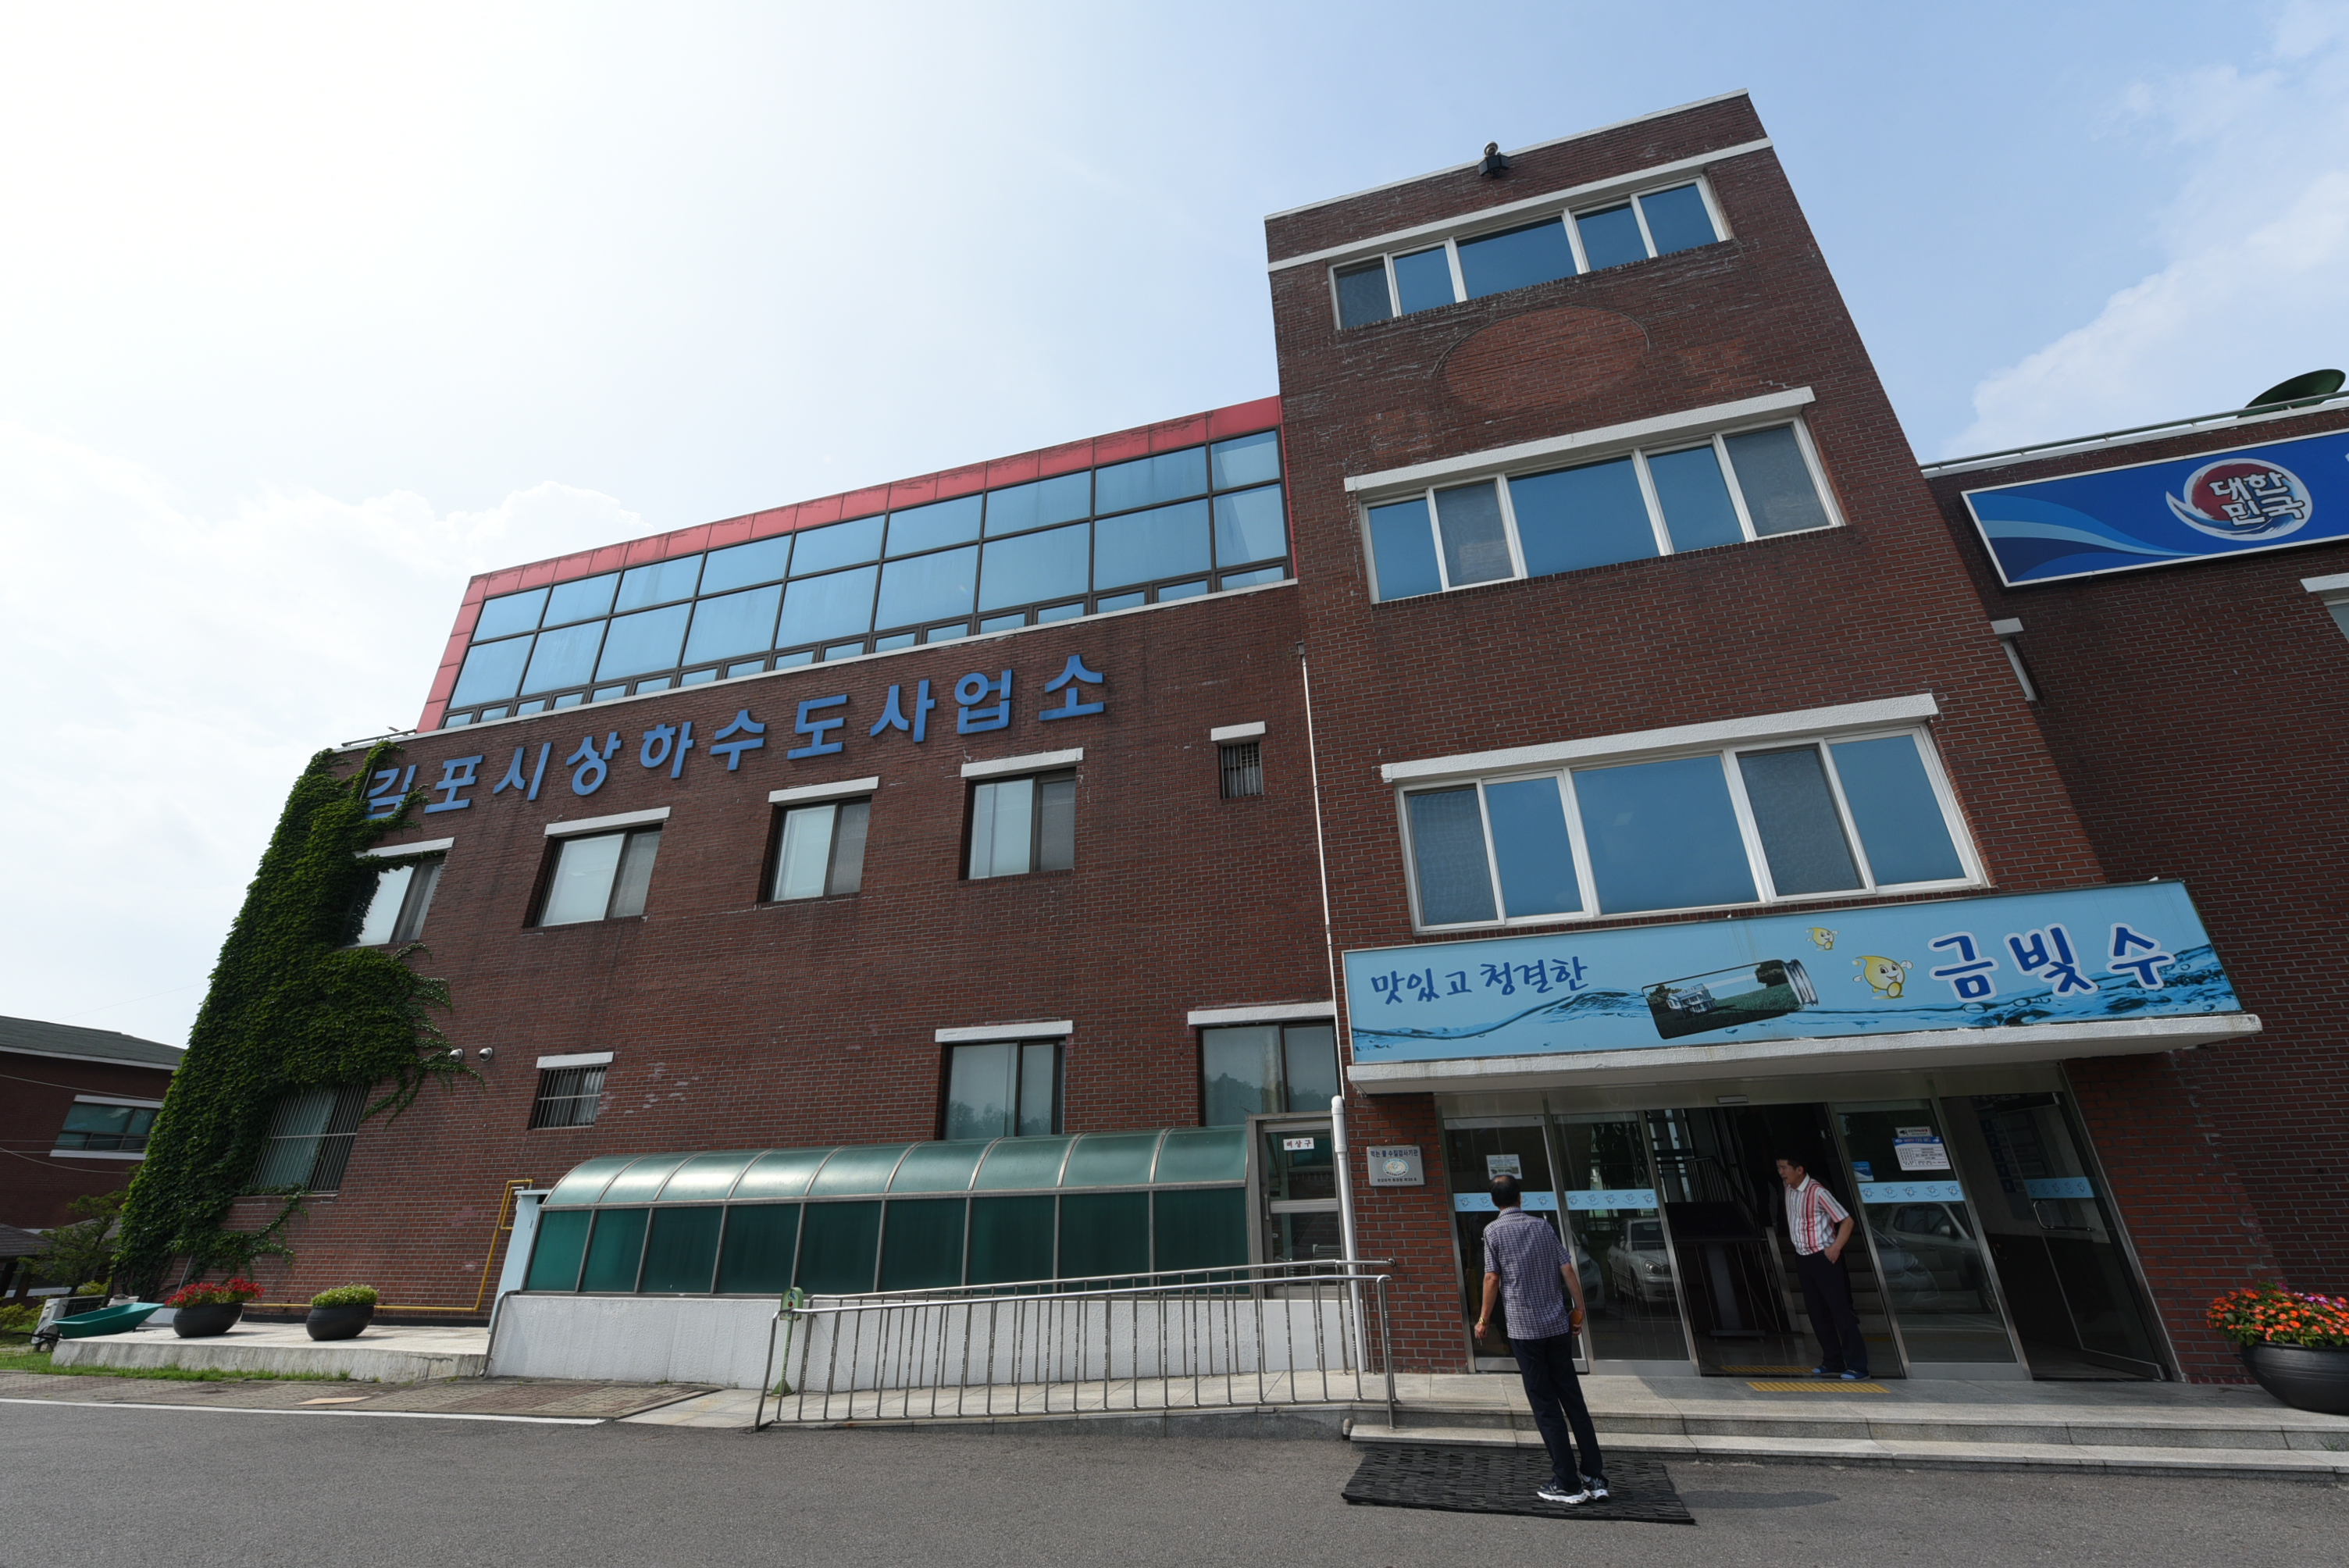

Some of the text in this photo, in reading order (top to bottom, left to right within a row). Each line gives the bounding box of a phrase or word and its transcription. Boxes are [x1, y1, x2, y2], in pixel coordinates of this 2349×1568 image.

[2208, 471, 2289, 501] 대한
[2220, 495, 2305, 526] 민국
[365, 654, 1104, 820] 김포시상하수도사업소
[1371, 955, 1589, 1005] 맛있고 청결한
[1286, 1139, 1312, 1149] 비상구
[1388, 1149, 1419, 1157] 수질검사기관
